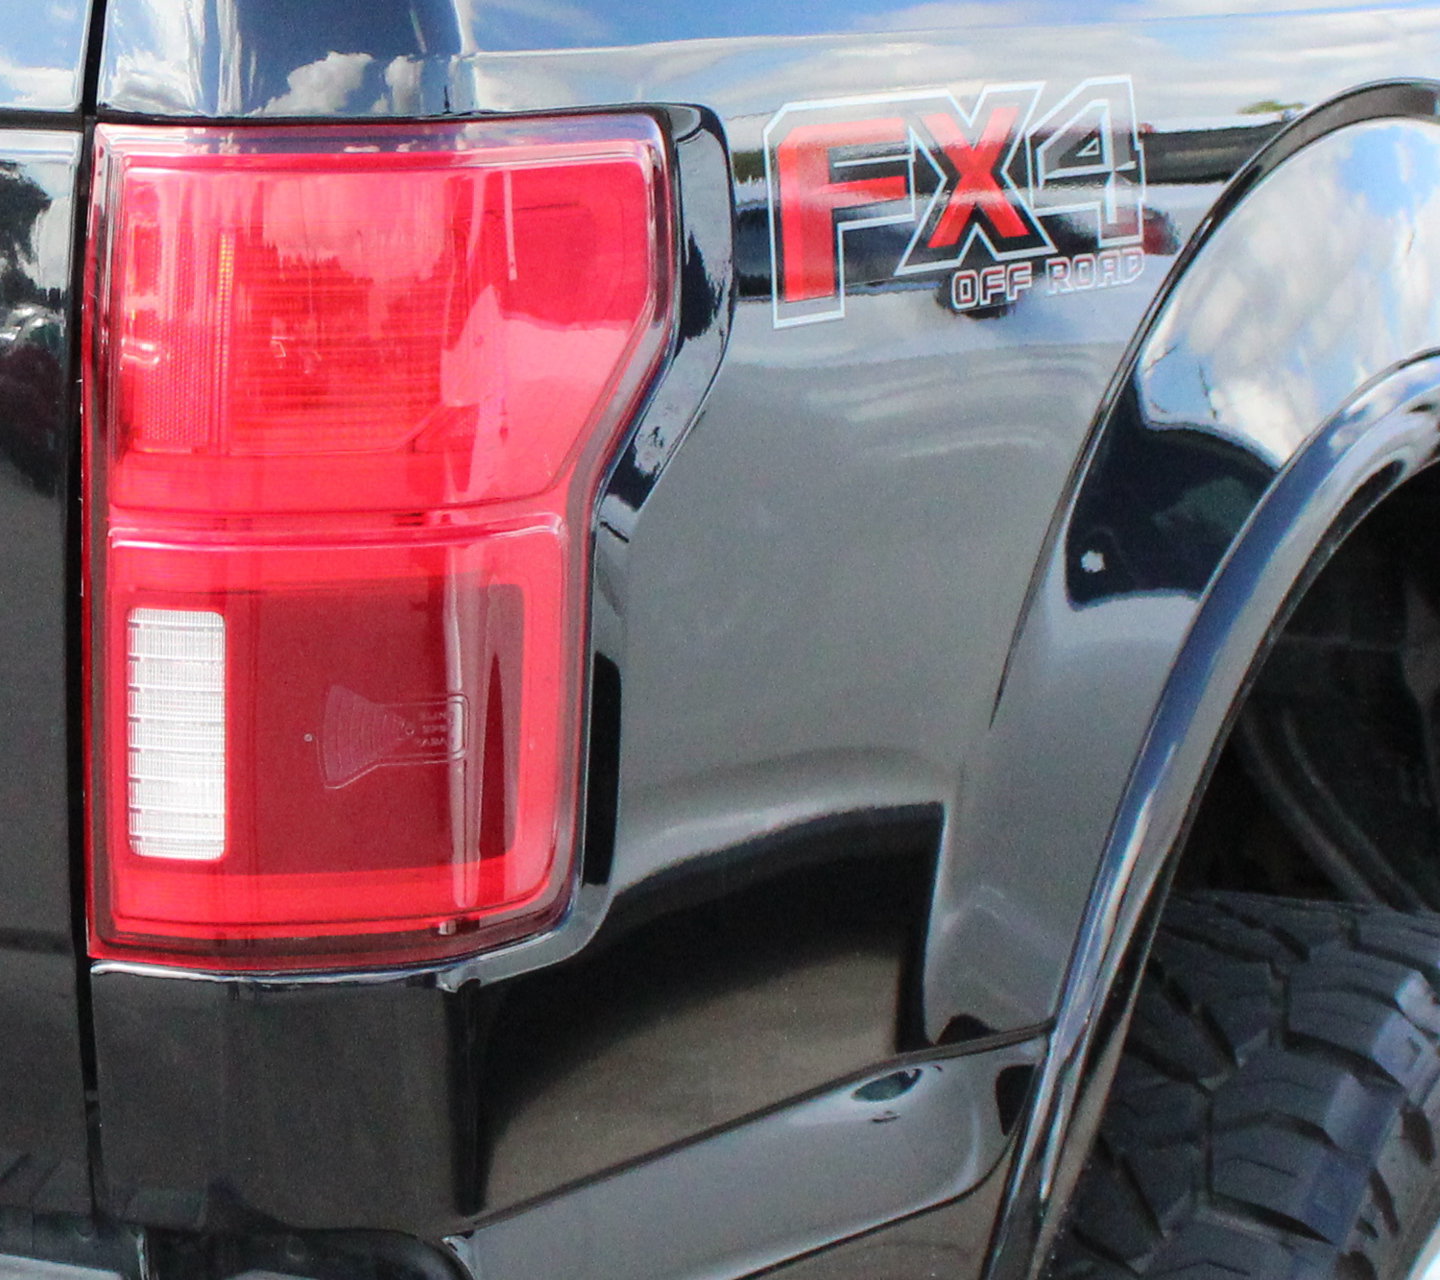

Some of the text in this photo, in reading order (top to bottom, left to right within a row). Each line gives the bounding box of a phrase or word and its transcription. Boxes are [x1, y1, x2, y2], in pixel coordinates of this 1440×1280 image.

[763, 74, 1146, 329] FX4
[950, 247, 1146, 311] OFF ROAD
